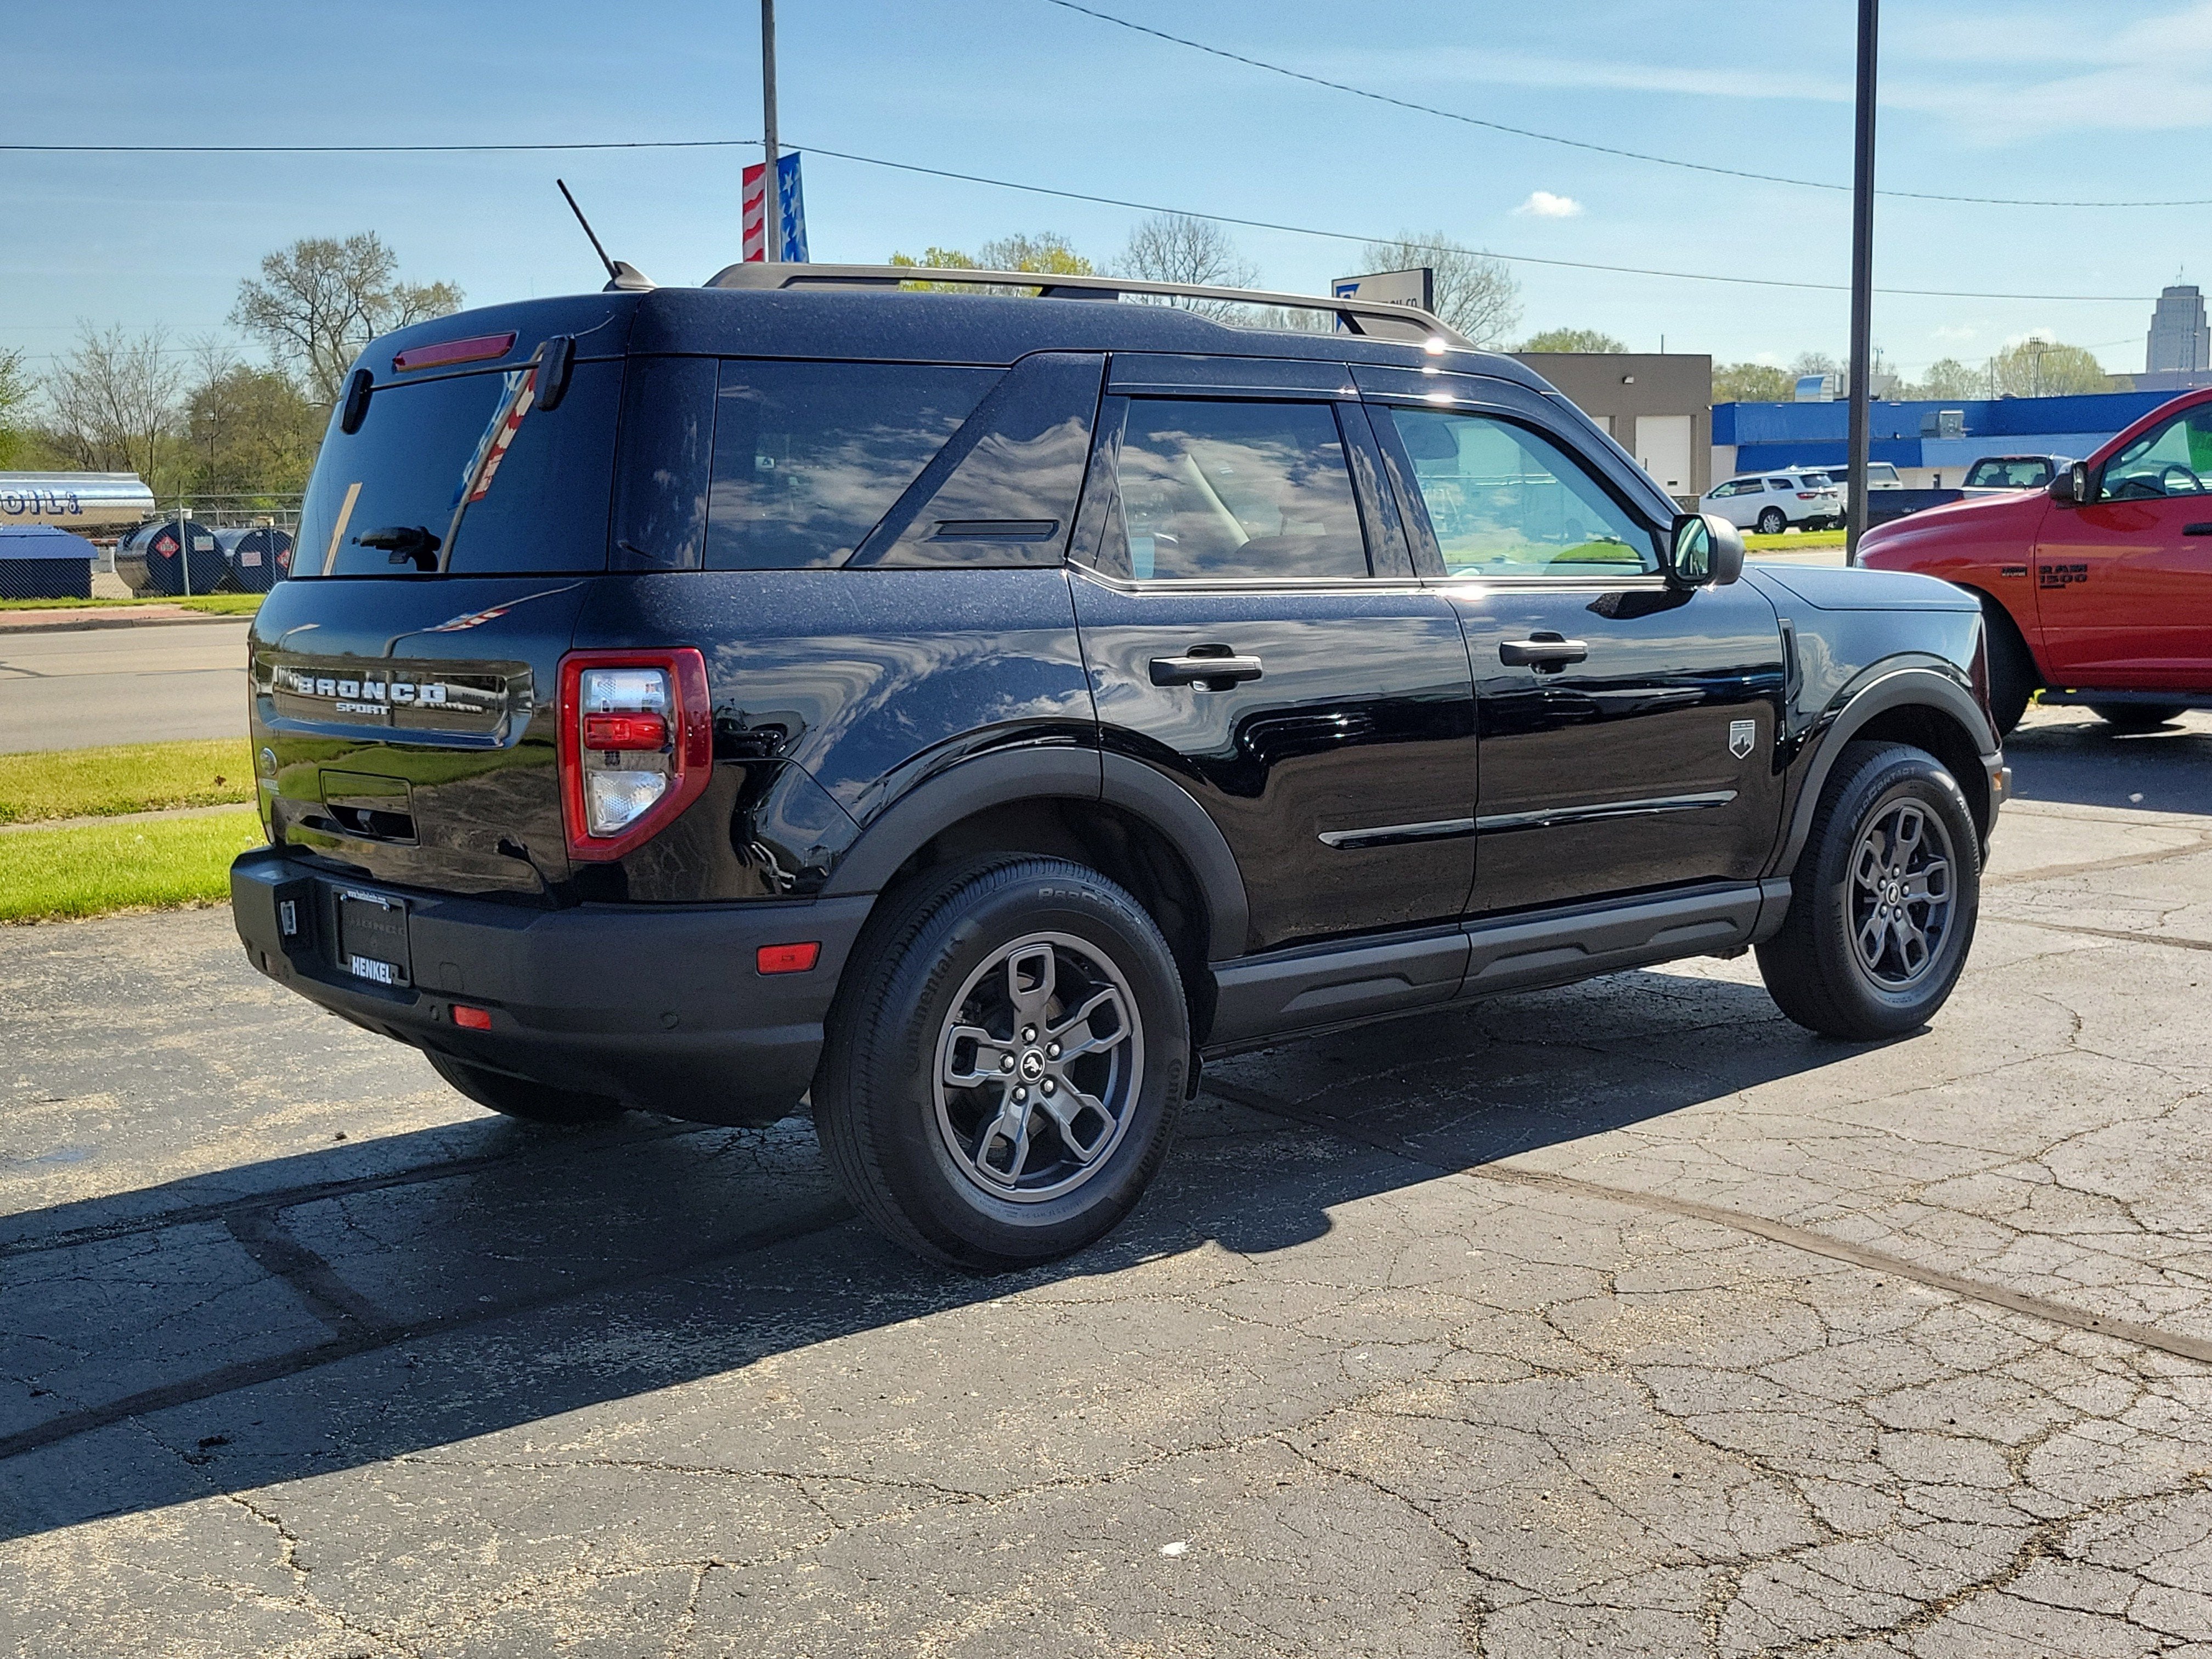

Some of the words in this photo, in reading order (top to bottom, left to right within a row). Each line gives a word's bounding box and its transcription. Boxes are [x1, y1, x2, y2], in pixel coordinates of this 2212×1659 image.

[2039, 564, 2087, 574] RAM
[2040, 574, 2087, 583] 1500
[298, 676, 447, 703] BRONCO
[336, 703, 390, 714] SPORT
[352, 956, 392, 984] HENKEL
